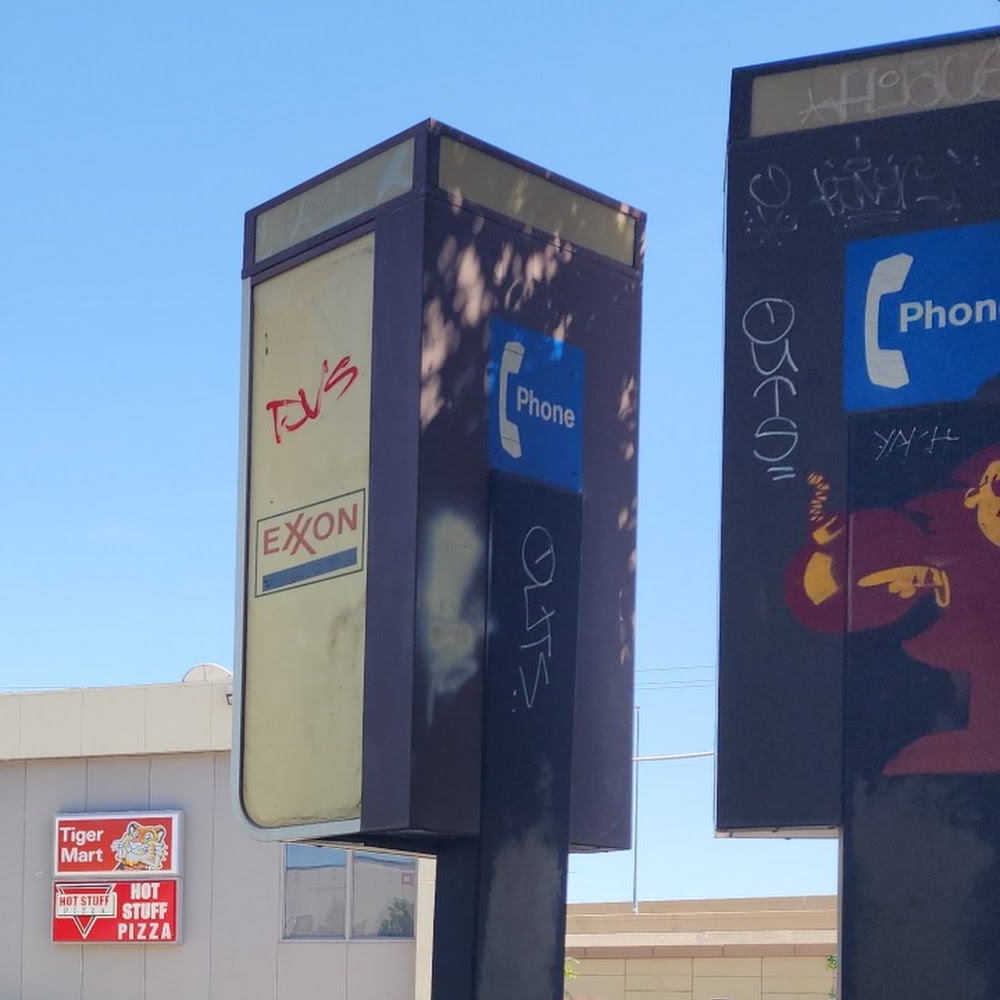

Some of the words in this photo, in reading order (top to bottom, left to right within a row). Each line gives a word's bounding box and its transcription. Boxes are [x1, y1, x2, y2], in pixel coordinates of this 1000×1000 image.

[900, 298, 1000, 333] Phon
[516, 386, 576, 429] Phone
[263, 503, 358, 556] EXXON
[59, 826, 104, 846] Tiger
[61, 847, 103, 863] Mart
[131, 882, 160, 900] HOT
[59, 895, 78, 907] HOT
[80, 895, 110, 906] STUFF
[122, 902, 168, 920] STUFF
[118, 922, 172, 940] PIZZA
